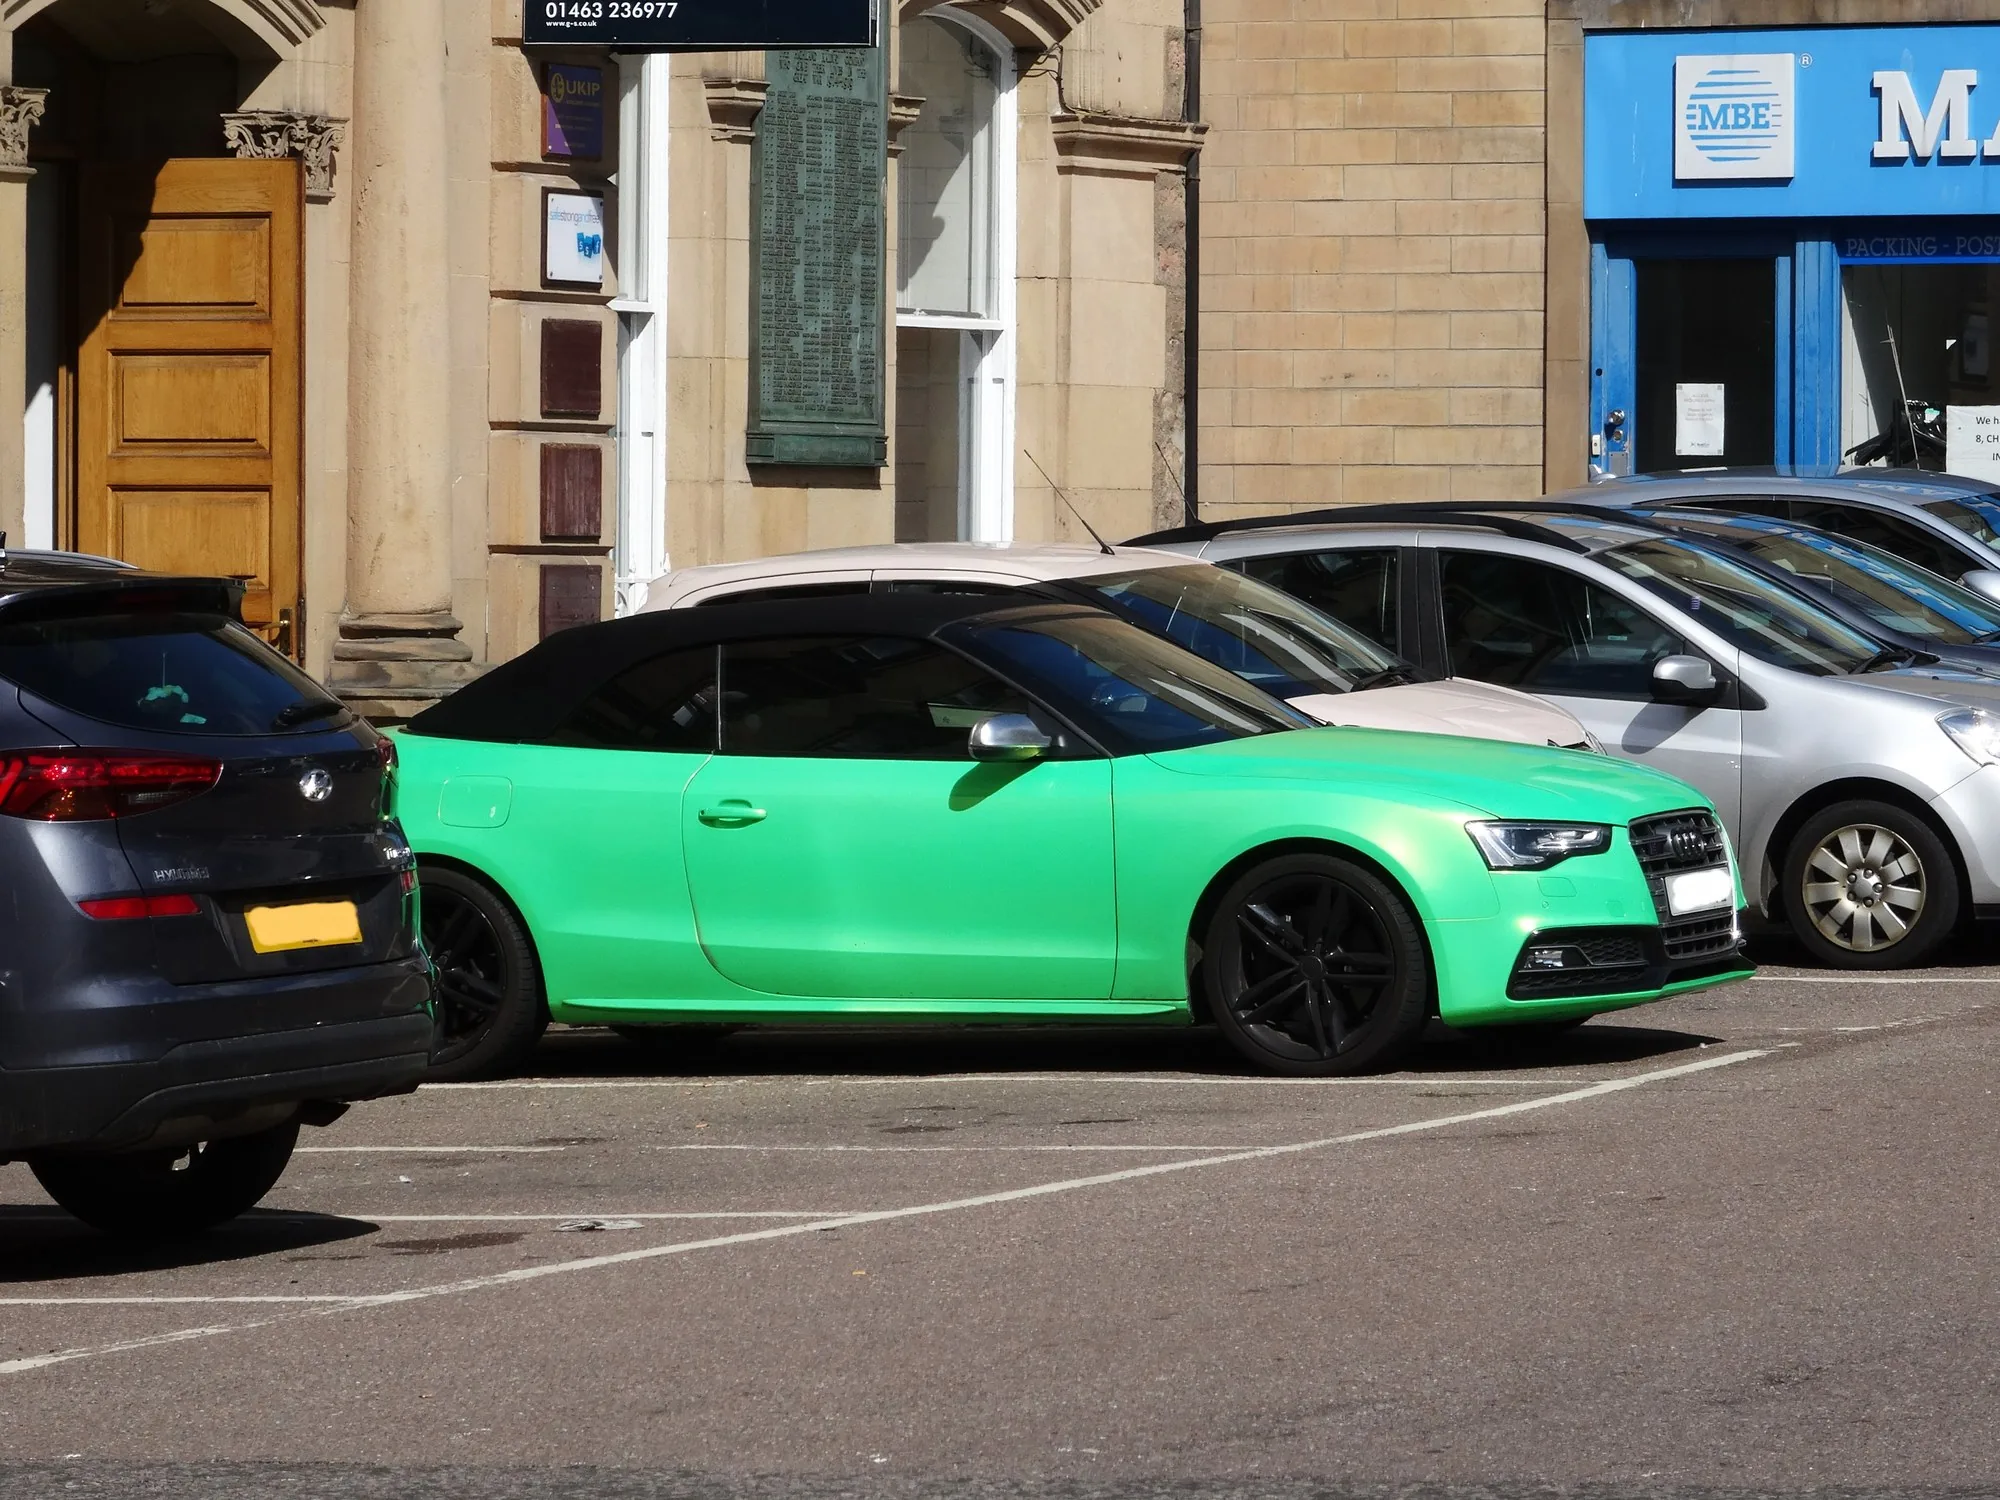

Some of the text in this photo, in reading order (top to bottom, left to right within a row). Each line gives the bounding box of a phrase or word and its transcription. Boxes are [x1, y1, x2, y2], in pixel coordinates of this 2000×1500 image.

[545, 2, 678, 18] 01463 236977
[545, 20, 598, 28] www.g-s.co.uk
[566, 80, 601, 97] UKIP
[1697, 102, 1771, 130] MBE
[1873, 68, 2000, 158] M
[1845, 236, 1938, 256] PACKING
[1976, 416, 2000, 425] We h
[1975, 434, 2000, 444] 8, CH
